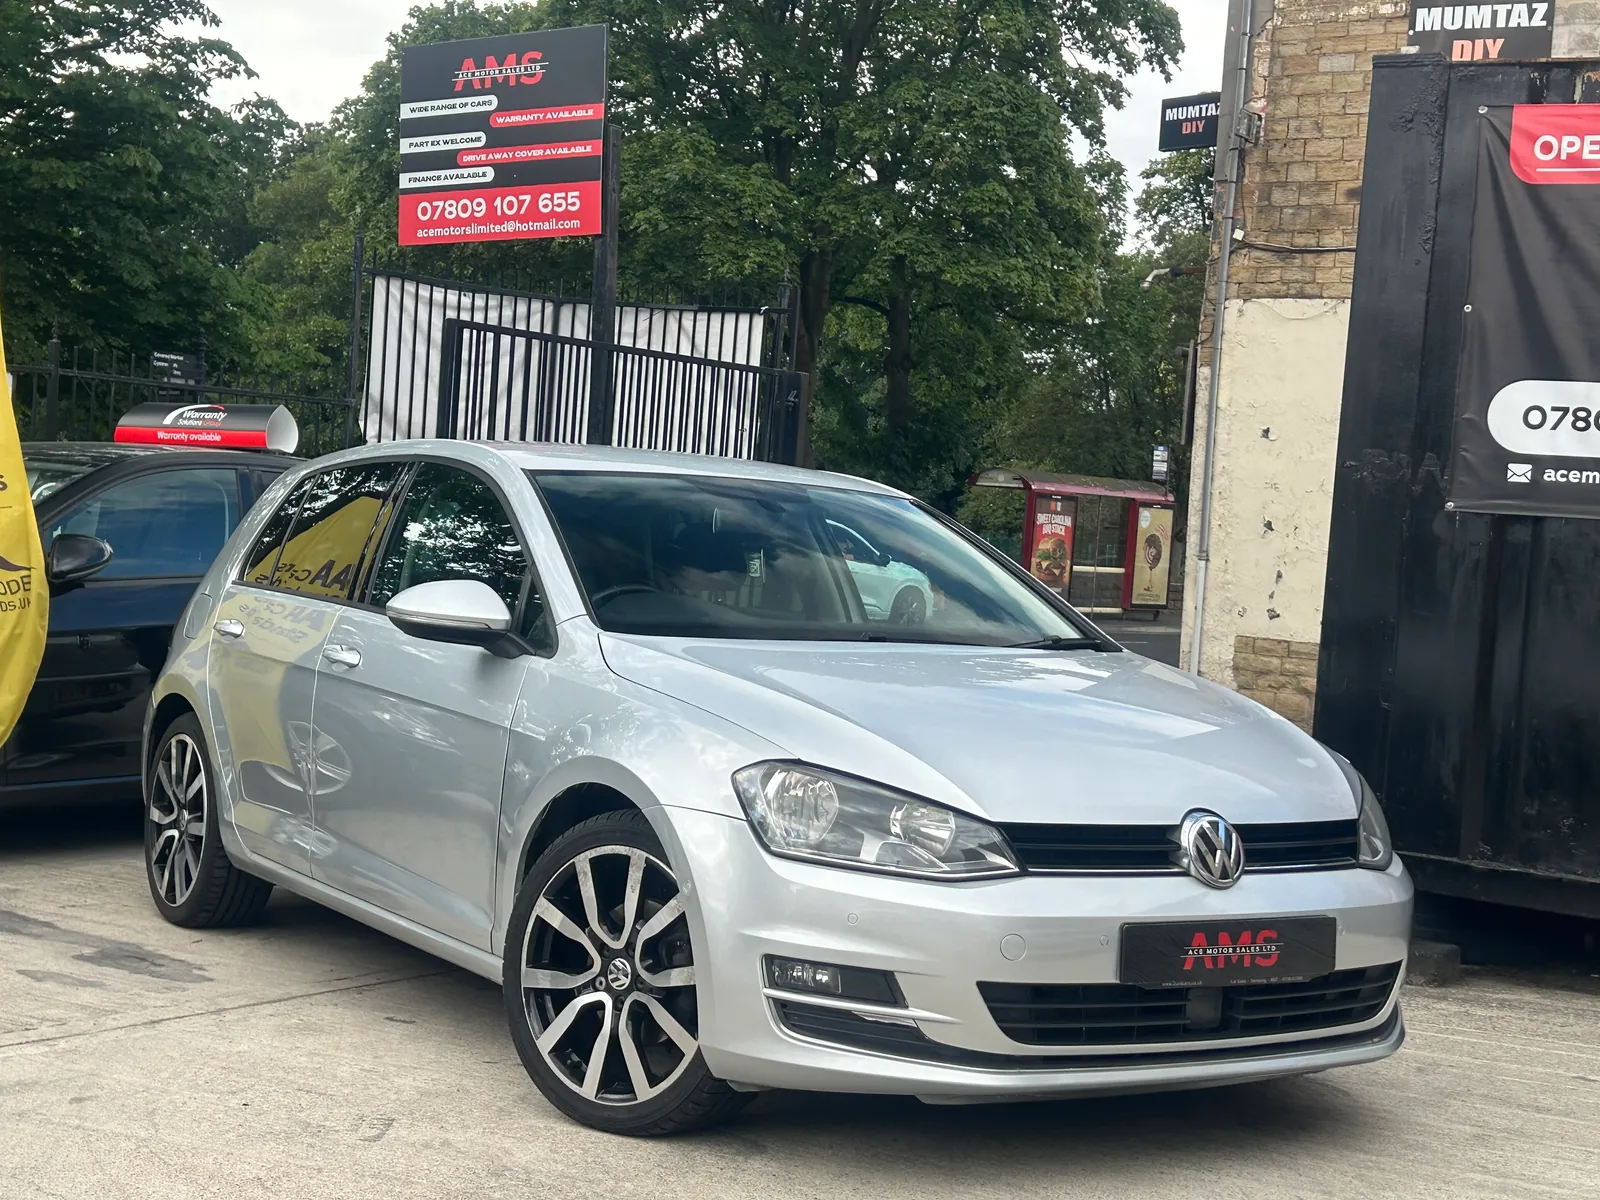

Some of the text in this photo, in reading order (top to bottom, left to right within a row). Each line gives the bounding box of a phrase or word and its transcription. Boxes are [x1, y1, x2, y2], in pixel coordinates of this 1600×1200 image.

[1415, 3, 1549, 31] MUMTAZ
[1452, 38, 1505, 61] DIY
[454, 51, 543, 91] AMS
[409, 105, 429, 113] WIDE
[430, 103, 457, 112] RANGE
[470, 99, 493, 108] CARS
[496, 109, 594, 124] WARRANTY AVAILABLE
[1182, 120, 1205, 134] DIY
[442, 136, 482, 146] WELCOME
[462, 145, 592, 162] DRIVE AWAY COVER AVAILABLE
[408, 171, 488, 184] FINANCE AVAILABLE
[416, 191, 580, 221] 07809 107 655
[416, 218, 580, 238] acemotorslimited@hotmail.com
[183, 410, 228, 422] Warranty
[157, 430, 222, 442] Warranty available
[1183, 930, 1278, 970] AMS
